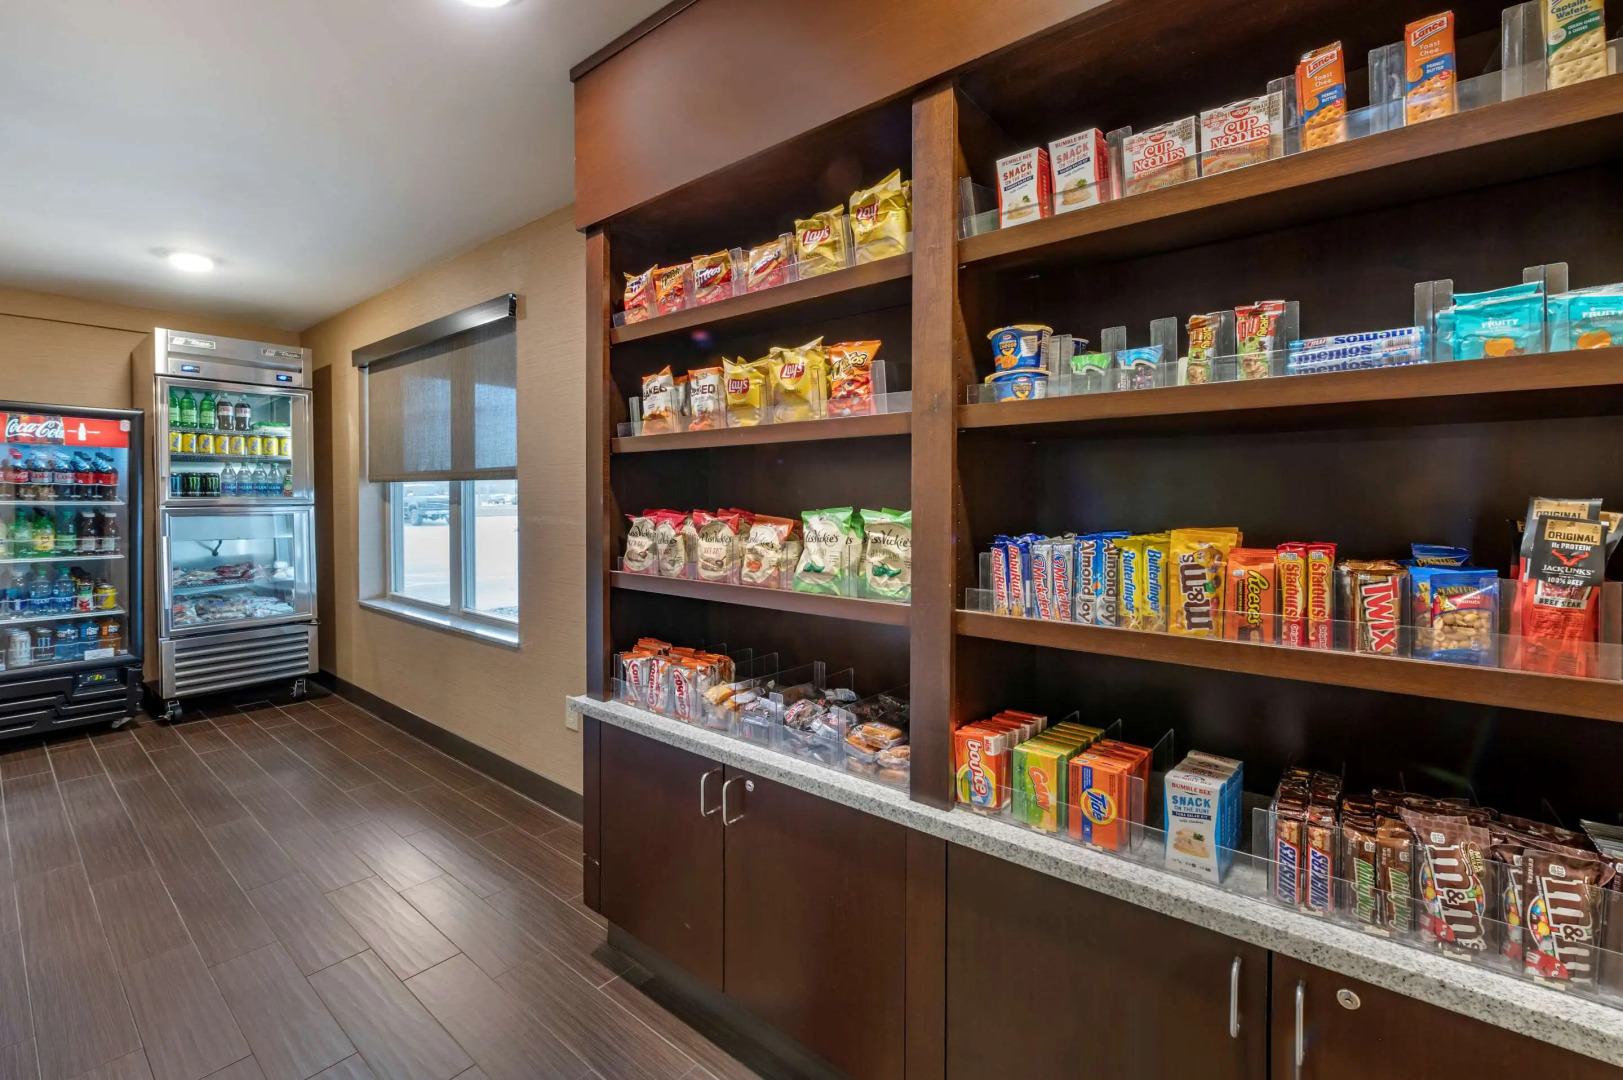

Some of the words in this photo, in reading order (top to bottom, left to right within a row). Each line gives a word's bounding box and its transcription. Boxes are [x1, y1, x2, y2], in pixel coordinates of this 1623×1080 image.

[1551, 0, 1592, 14] Captain
[1556, 4, 1589, 19] Wafers
[1413, 18, 1446, 42] Lance
[1419, 40, 1441, 50] Toast
[1308, 52, 1336, 74] Lance
[1426, 60, 1445, 69] PEANUT
[1426, 65, 1445, 74] BUTTER
[1313, 71, 1332, 81] Toast
[1224, 116, 1259, 136] CUP
[1211, 124, 1271, 149] NOODLES
[1056, 142, 1090, 164] SNACK
[1144, 140, 1175, 158] CUP
[1133, 147, 1186, 173] NOODLES
[1003, 161, 1033, 181] SNACK
[804, 225, 830, 246] Lay's
[1481, 319, 1518, 329] FRUITY
[1296, 344, 1373, 364] mentos
[781, 361, 805, 379] Lay's
[728, 378, 749, 394] Lay's
[1549, 531, 1598, 544] ORIGINAL
[1561, 543, 1592, 551] PROTEIN
[1080, 540, 1096, 596] Almond
[1542, 564, 1564, 573] JACK
[1122, 550, 1136, 614] Butterfinger
[1147, 549, 1162, 613] Butterfinger
[1548, 577, 1566, 585] 100%
[1033, 566, 1051, 620] Musketeer
[1053, 566, 1072, 621] Musketeer
[1247, 570, 1270, 625] Reese's
[1285, 562, 1300, 621] Starburst
[1311, 562, 1328, 621] Starburst
[1078, 595, 1095, 623] Joy
[1539, 598, 1559, 607] BEEF
[1364, 577, 1399, 651] TWIX
[967, 740, 987, 796] bounce
[1172, 783, 1198, 792] BUMBLE
[1086, 790, 1107, 822] Tide
[1172, 795, 1211, 808] SNACK
[1476, 851, 1484, 871] MILK
[1311, 850, 1329, 909] SNICKERS
